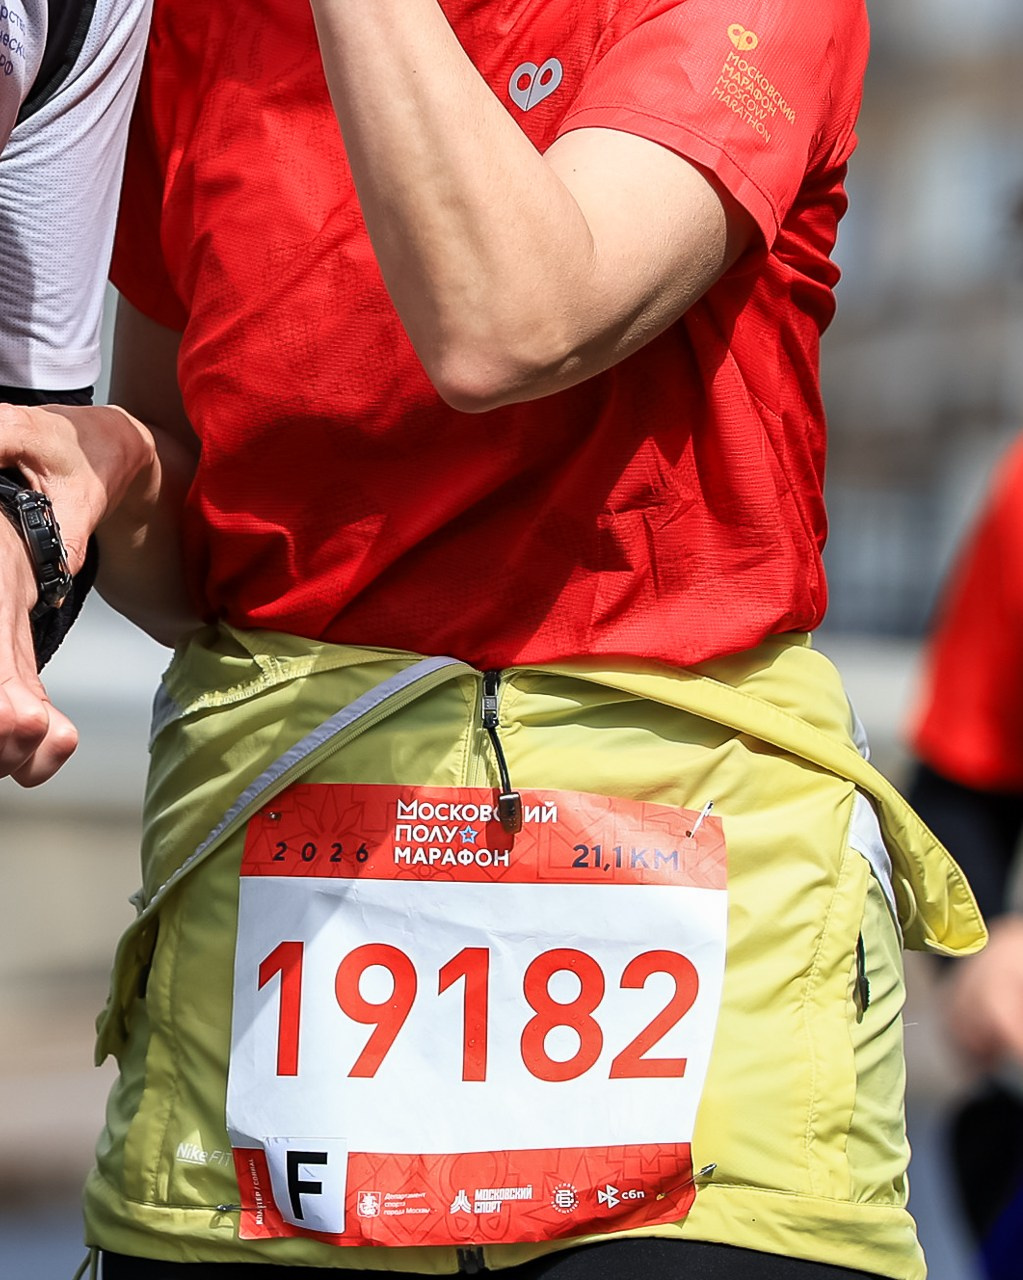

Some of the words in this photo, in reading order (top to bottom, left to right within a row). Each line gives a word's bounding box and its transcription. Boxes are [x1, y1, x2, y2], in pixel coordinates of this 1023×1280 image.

[716, 75, 768, 120] MOSCOW
[721, 63, 778, 117] МАРАФОН
[726, 50, 797, 125] МОСКОВСКИЙ
[711, 86, 772, 144] MARATHON
[396, 798, 559, 824] МОСКОВИЙ
[394, 824, 458, 844] ПОЛУ
[273, 841, 370, 864] 2026
[394, 846, 510, 867] МАРАФОН
[257, 940, 700, 1083] 19182
[176, 1142, 207, 1163] Nike
[286, 1150, 328, 1220] F
[474, 1185, 533, 1201] МОСКОВСКИЙ
[621, 1189, 645, 1200] сбп
[473, 1201, 502, 1214] СПОРТ
